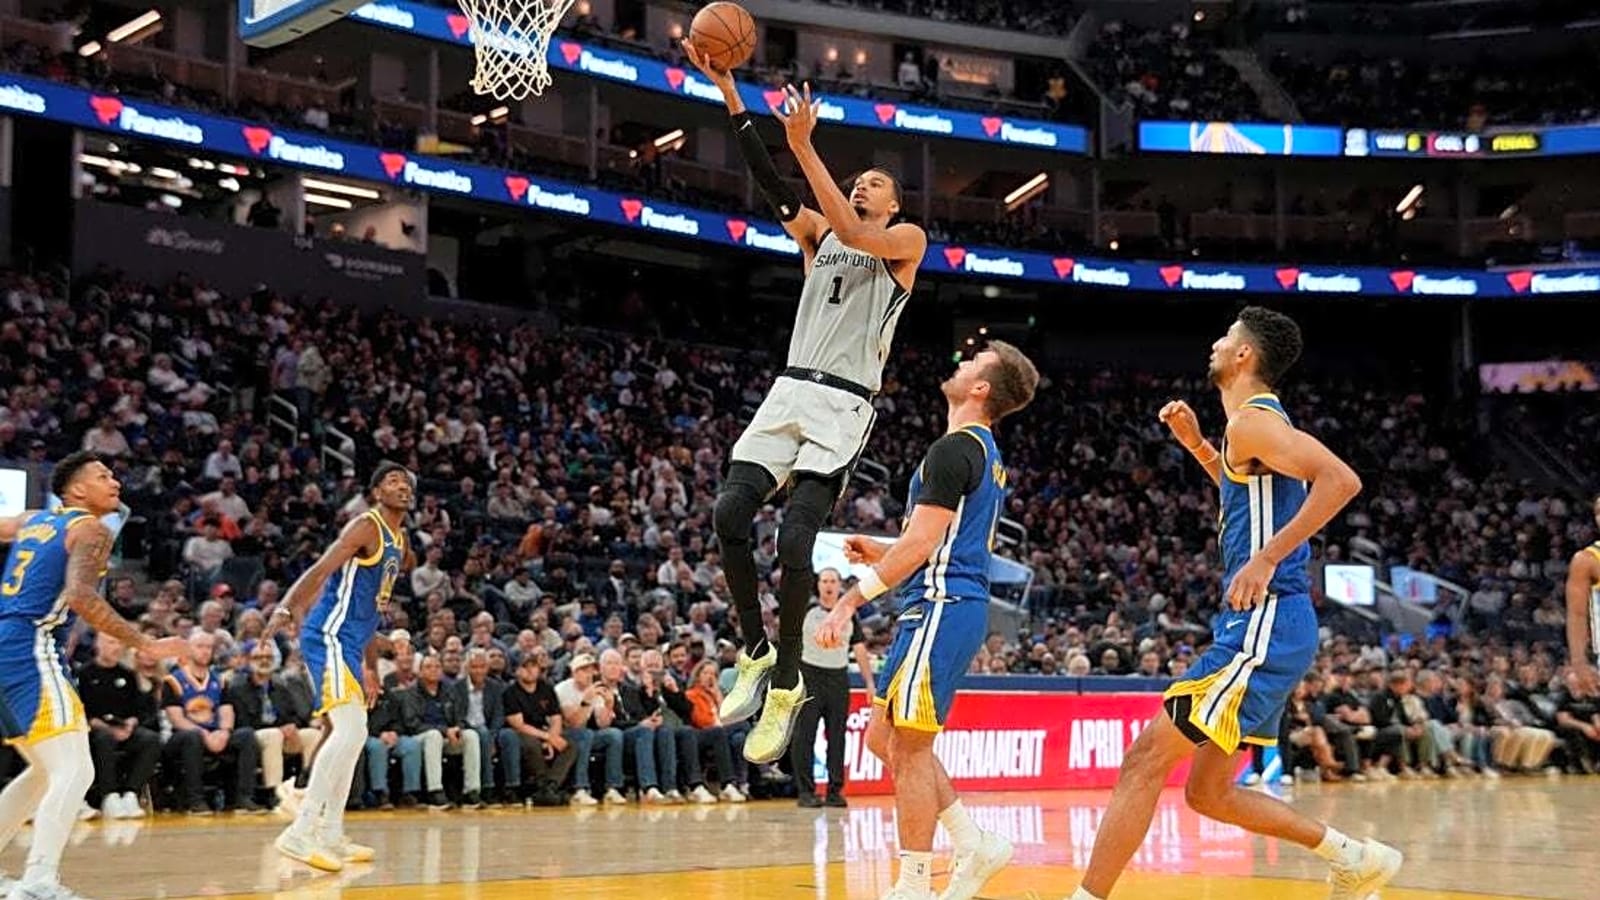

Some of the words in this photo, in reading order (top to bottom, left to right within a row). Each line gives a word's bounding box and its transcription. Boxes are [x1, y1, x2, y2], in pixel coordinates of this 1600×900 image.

[580, 50, 638, 82] Fanatics
[684, 75, 726, 103] Fana
[120, 106, 204, 144] Fanatics
[894, 109, 953, 134] Fanatics
[1001, 122, 1057, 147] Fanatics
[269, 135, 344, 170] Fanatics
[404, 161, 472, 193] Fanatics
[527, 184, 590, 215] Fanatics
[641, 206, 699, 236] Fanatics
[814, 253, 838, 268] SAN
[965, 252, 1024, 277] Fanatics
[1072, 263, 1130, 287] Fanatics
[827, 275, 844, 305] 1
[1182, 270, 1246, 290] Fanatics
[1298, 272, 1362, 292] Fanatics
[1412, 274, 1477, 295] Fanatics
[2, 549, 36, 596] 3
[846, 707, 873, 730] oF
[932, 729, 1047, 779] OURNAMENT
[1068, 719, 1124, 769] APRIL
